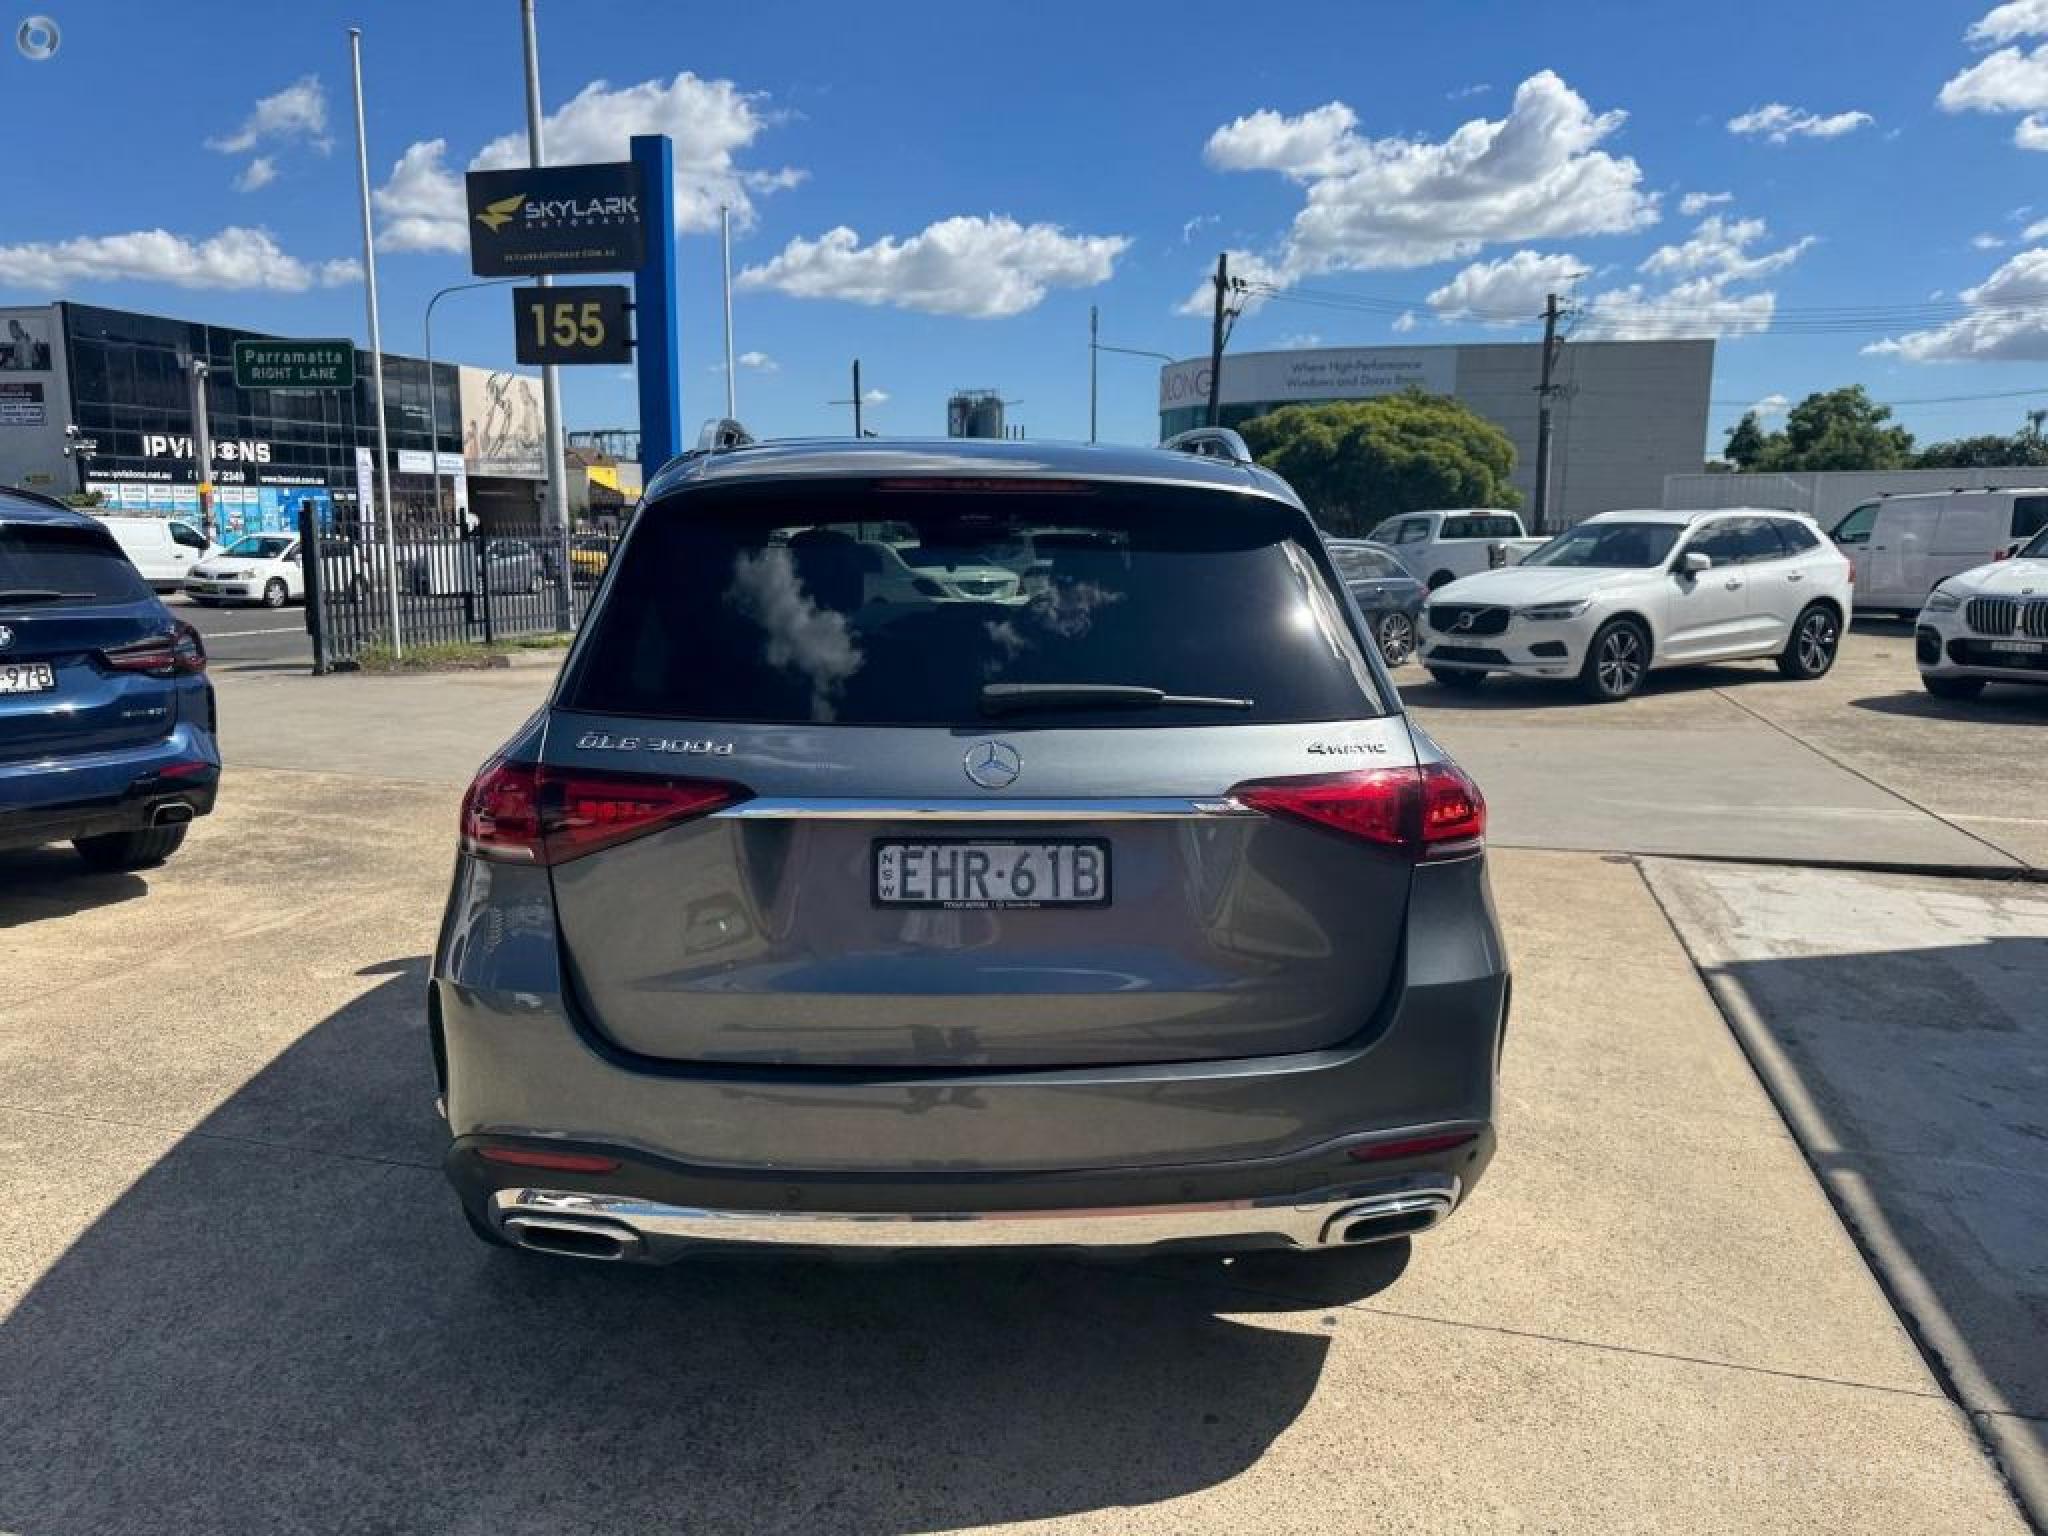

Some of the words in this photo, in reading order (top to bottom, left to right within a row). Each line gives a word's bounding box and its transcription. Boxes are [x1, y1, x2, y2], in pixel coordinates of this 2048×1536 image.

[525, 196, 637, 219] SKYLARK
[531, 303, 605, 347] 155
[245, 350, 342, 365] Parramatta
[251, 367, 291, 379] RIGHT
[299, 367, 337, 379] LANE
[143, 435, 271, 463] IPVIIONS
